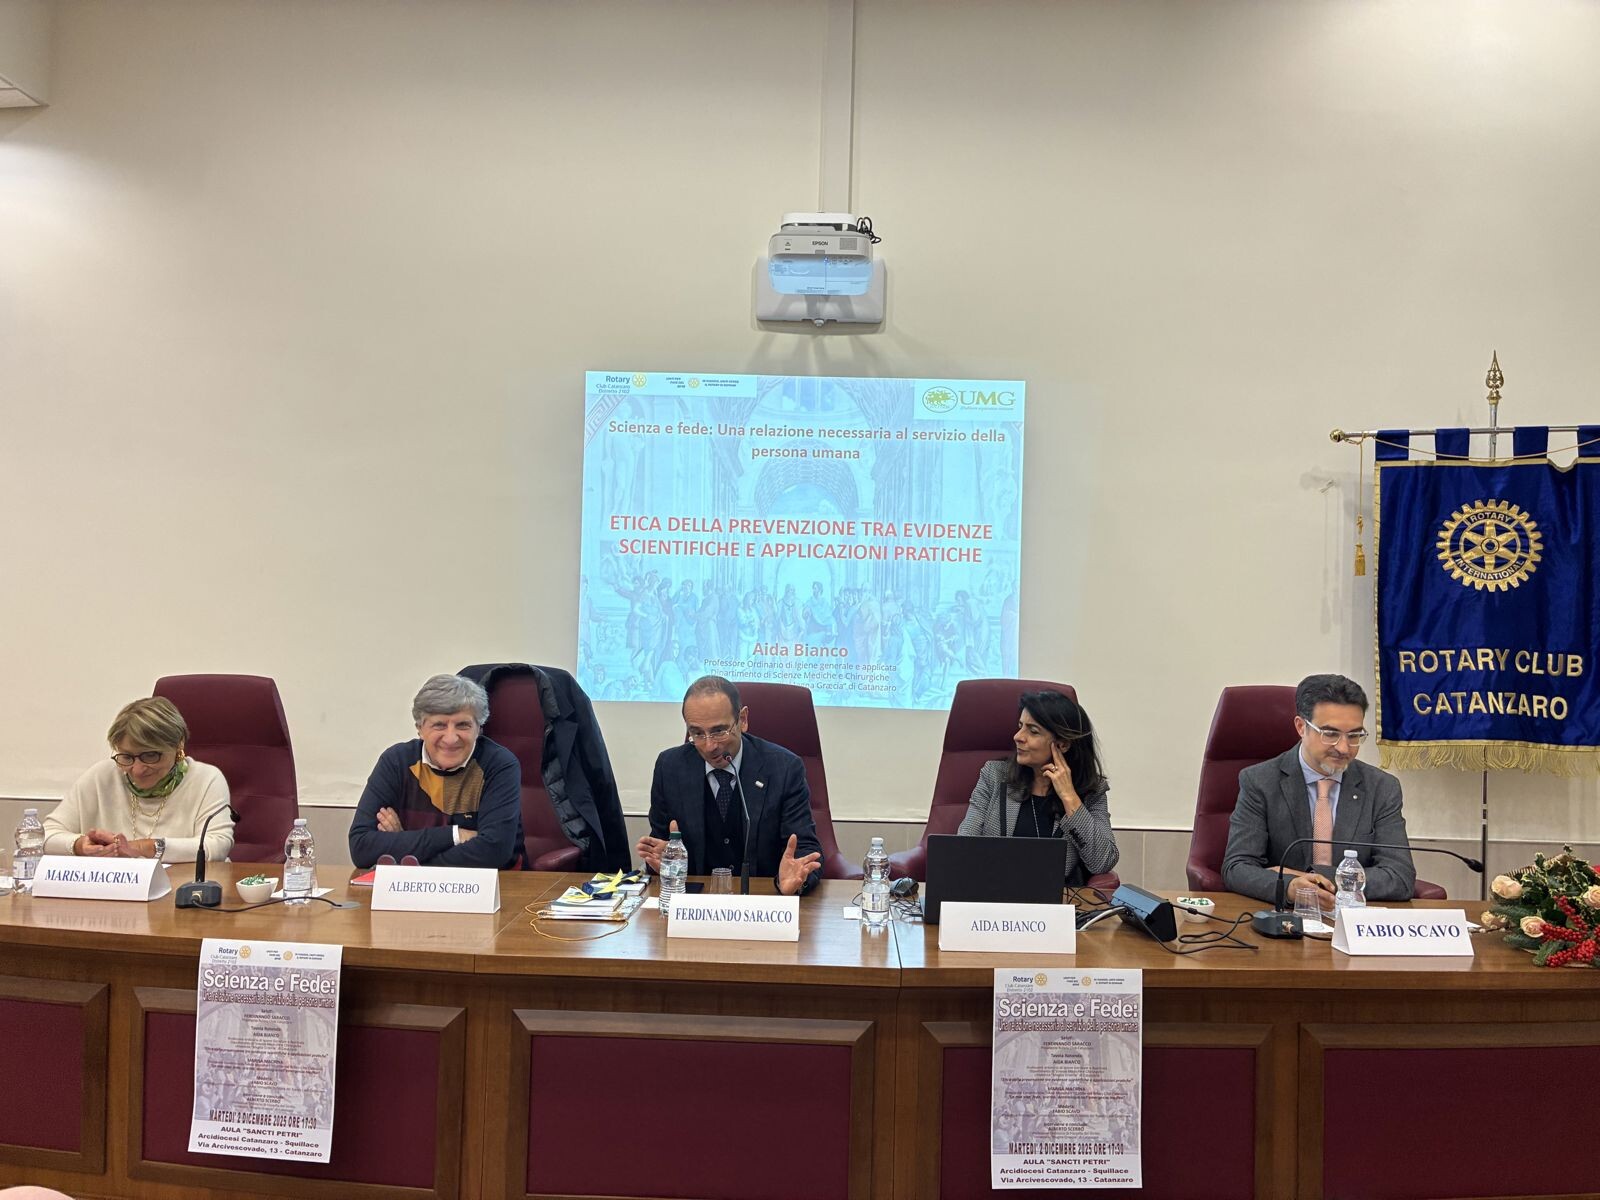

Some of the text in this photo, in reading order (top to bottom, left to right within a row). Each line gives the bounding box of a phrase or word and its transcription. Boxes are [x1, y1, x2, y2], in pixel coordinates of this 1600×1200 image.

[606, 376, 630, 384] Rotary
[958, 390, 1016, 406] UMG
[608, 420, 1005, 442] Scienza e fede: Una relazione necessaria al servizio della
[752, 448, 860, 459] persona umana
[1470, 512, 1512, 522] ROTARY
[610, 515, 992, 540] ETICA DELLA PREVENZIONE TRA EVIDENZE
[619, 539, 982, 563] SCIENTIFICHE E APPLICAZIONI PRATICHE
[1455, 558, 1525, 580] INTERNATIONAL
[752, 643, 848, 657] Aida Bianco
[704, 659, 745, 667] Professore
[795, 662, 818, 671] Igiene
[820, 663, 853, 671] generale
[862, 664, 897, 672] applicata
[1399, 648, 1583, 677] ROTARY CLUB
[773, 671, 802, 679] Scienze
[804, 672, 837, 680] Mediche
[846, 673, 890, 682] Chirurgiche
[858, 683, 896, 691] Catanzaro
[1413, 692, 1568, 720] CATANZARO
[45, 869, 86, 882] MARISA
[88, 871, 139, 884] MACRINA
[389, 881, 479, 894] ALBERTO SCERBO
[675, 908, 792, 923] FERDINANDO SARACCO
[971, 920, 1046, 932] AIDA BIANCO
[1356, 925, 1460, 937] FABIO SCAVO
[219, 947, 238, 955] Rotary
[203, 969, 336, 994] Scienza e Fede:
[1000, 998, 1138, 1018] Scienza e Fede:
[210, 1110, 317, 1130] MARTEDI' 2 DICEMBRE 2025 ORE 17:30
[243, 1128, 274, 1136] "SANCTI
[198, 1133, 239, 1142] Arcidiocesi
[241, 1137, 278, 1145] Catanzaro
[285, 1140, 319, 1149] Squillace
[212, 1143, 267, 1154] Arcivescovado,
[285, 1149, 322, 1157] Catanzaro
[1040, 1143, 1043, 1154] 2
[1045, 1143, 1076, 1155] DICEMBRE
[1078, 1143, 1092, 1155] 2025
[1094, 1143, 1106, 1155] ORE
